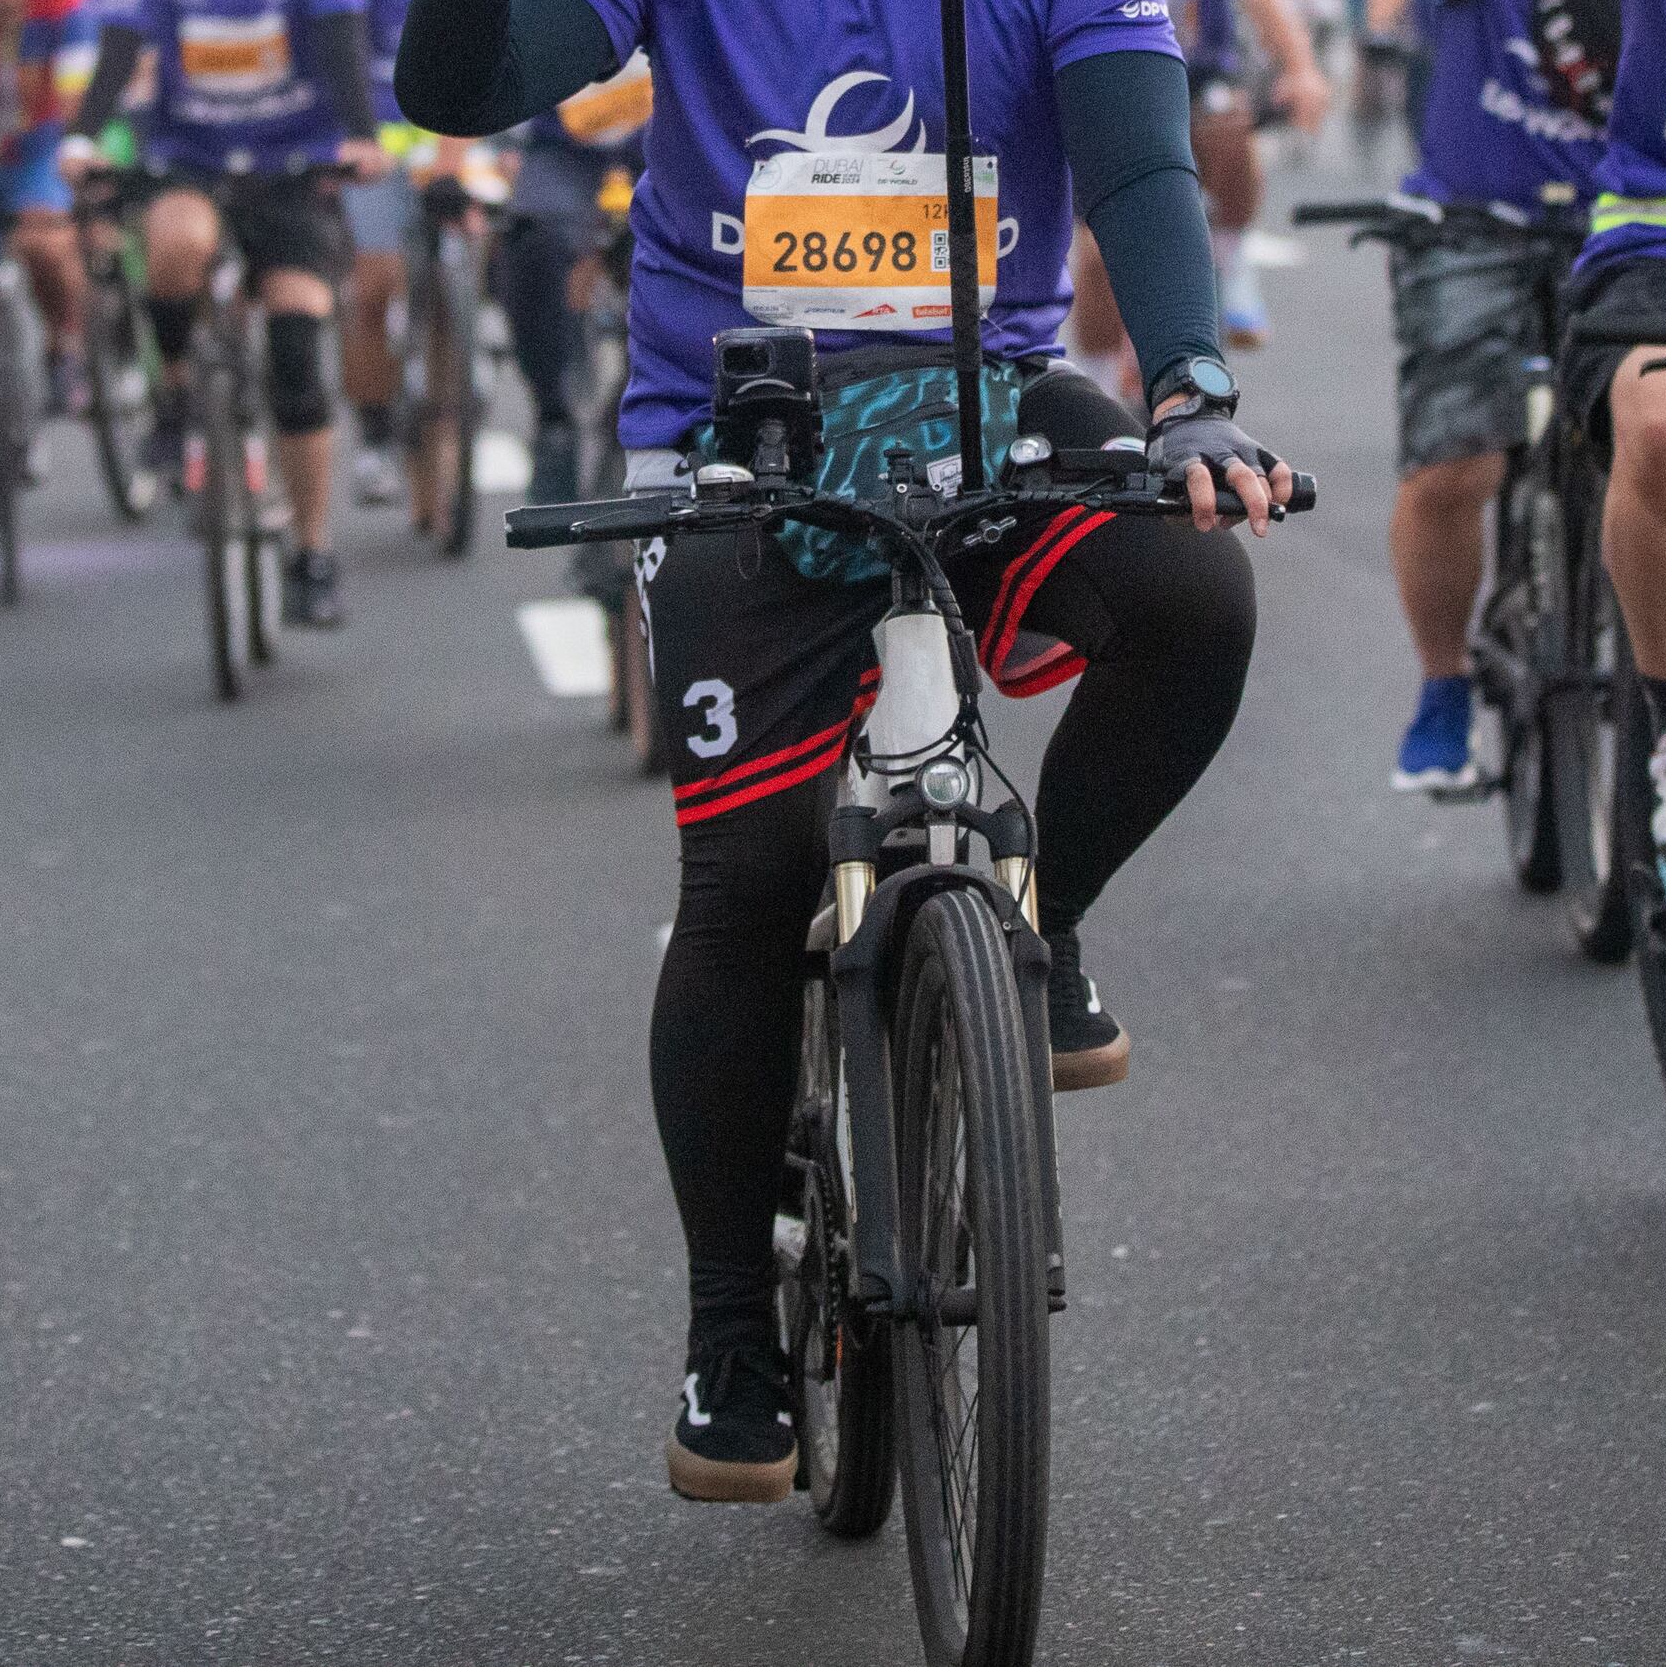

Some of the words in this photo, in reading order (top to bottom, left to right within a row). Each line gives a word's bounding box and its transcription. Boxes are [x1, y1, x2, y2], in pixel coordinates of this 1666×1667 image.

[811, 173, 841, 184] RIDE
[773, 231, 917, 273] 28698
[683, 679, 737, 759] 3
